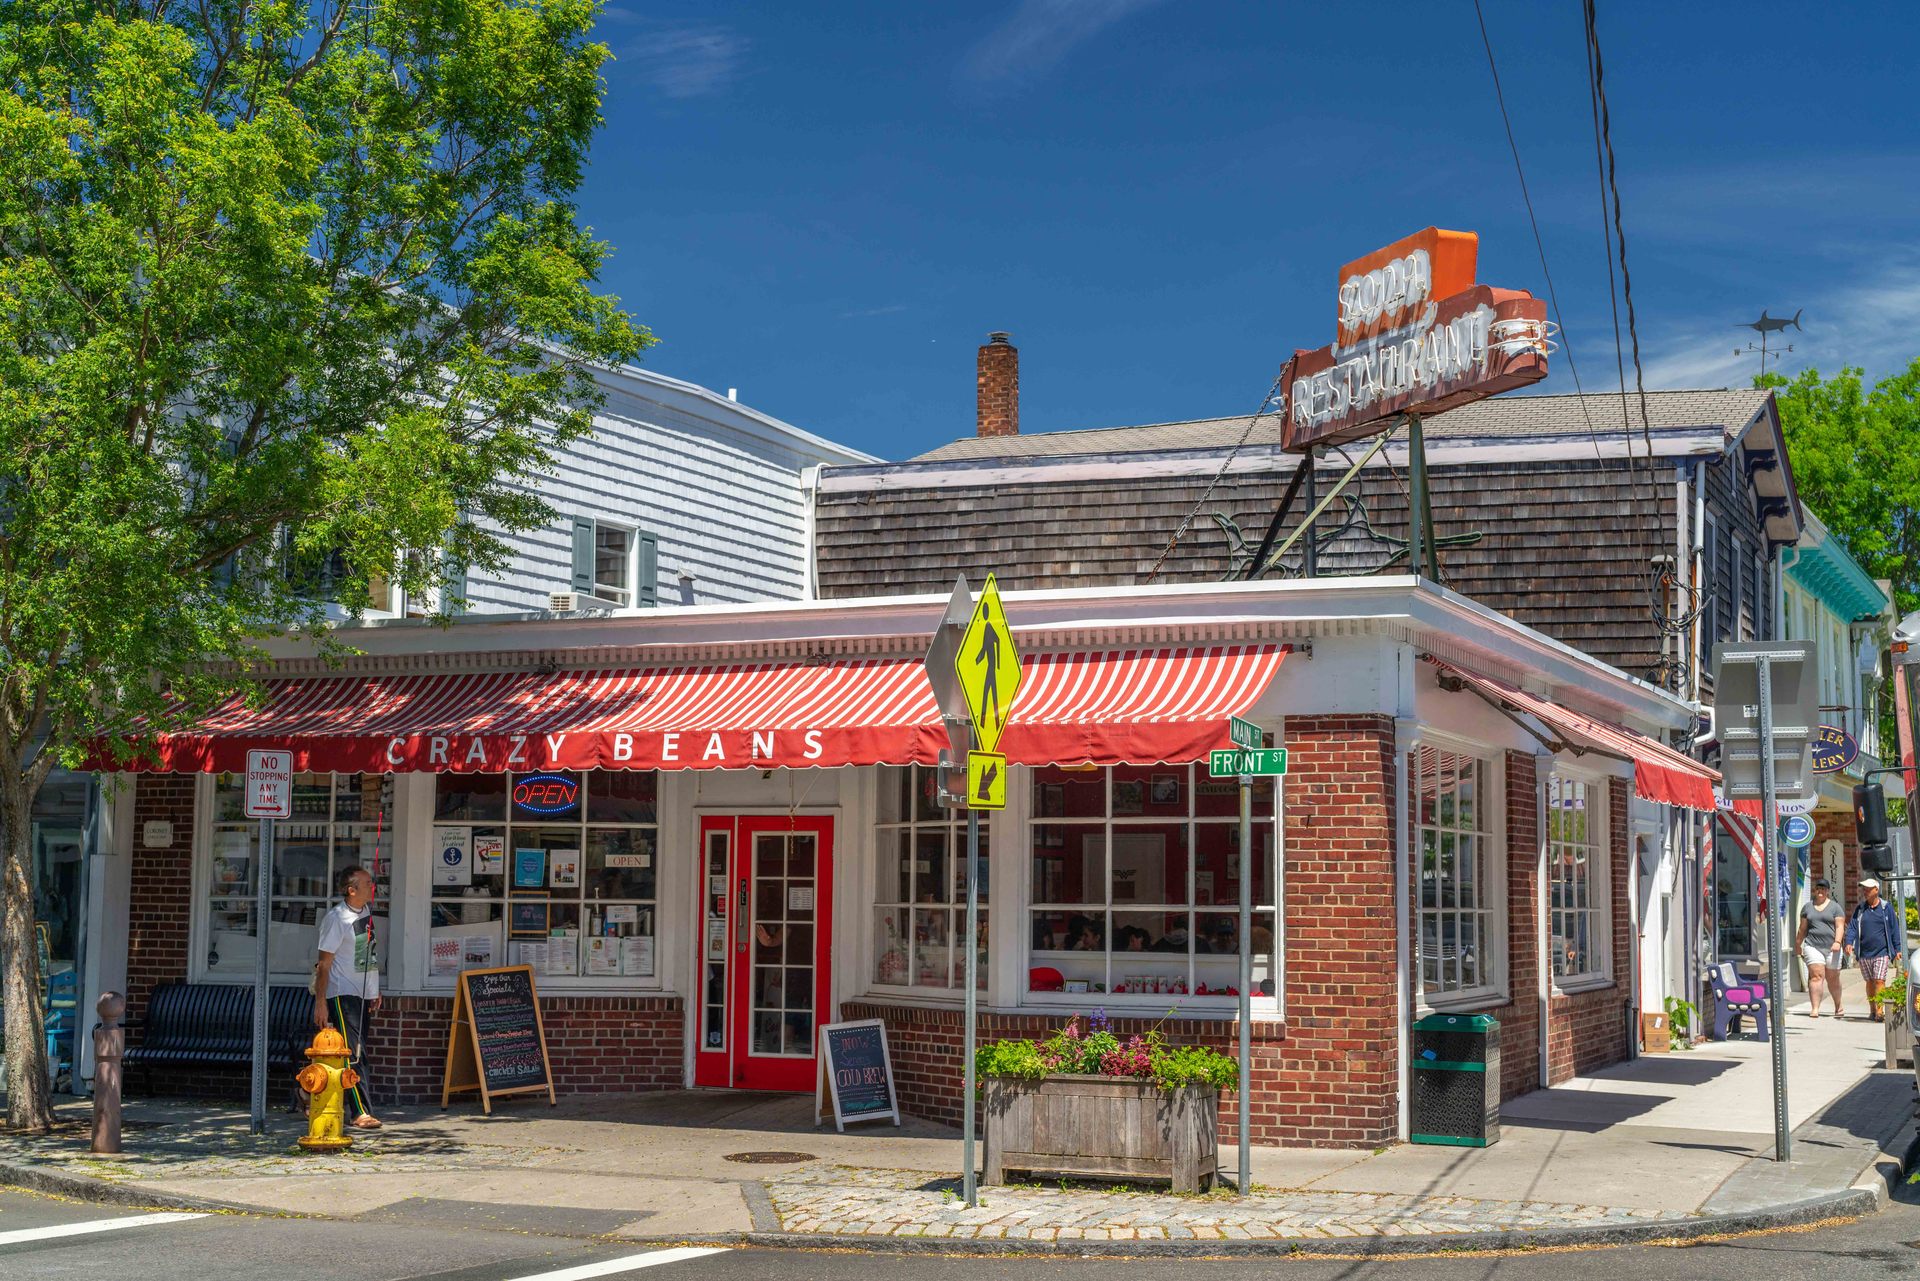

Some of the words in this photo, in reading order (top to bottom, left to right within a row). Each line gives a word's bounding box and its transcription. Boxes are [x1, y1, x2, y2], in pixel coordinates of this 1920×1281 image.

[1338, 253, 1428, 324] SODA
[1291, 310, 1485, 427] RESTAURANT
[1233, 719, 1252, 747] MAIN
[1254, 729, 1260, 740] ST
[386, 734, 566, 764] CRAZY
[613, 729, 824, 761] BEANS
[261, 757, 278, 770] NO
[1213, 752, 1265, 773] FRONT
[1272, 752, 1283, 763] ST
[1811, 751, 1847, 769] LERY
[250, 771, 289, 782] STOPPING
[259, 783, 278, 792] ANY
[513, 784, 578, 804] OPEN
[259, 794, 278, 804] TIME
[1778, 803, 1806, 813] ALON
[612, 856, 642, 866] OPEN
[837, 1069, 862, 1088] COLD
[862, 1067, 886, 1085] BREW
